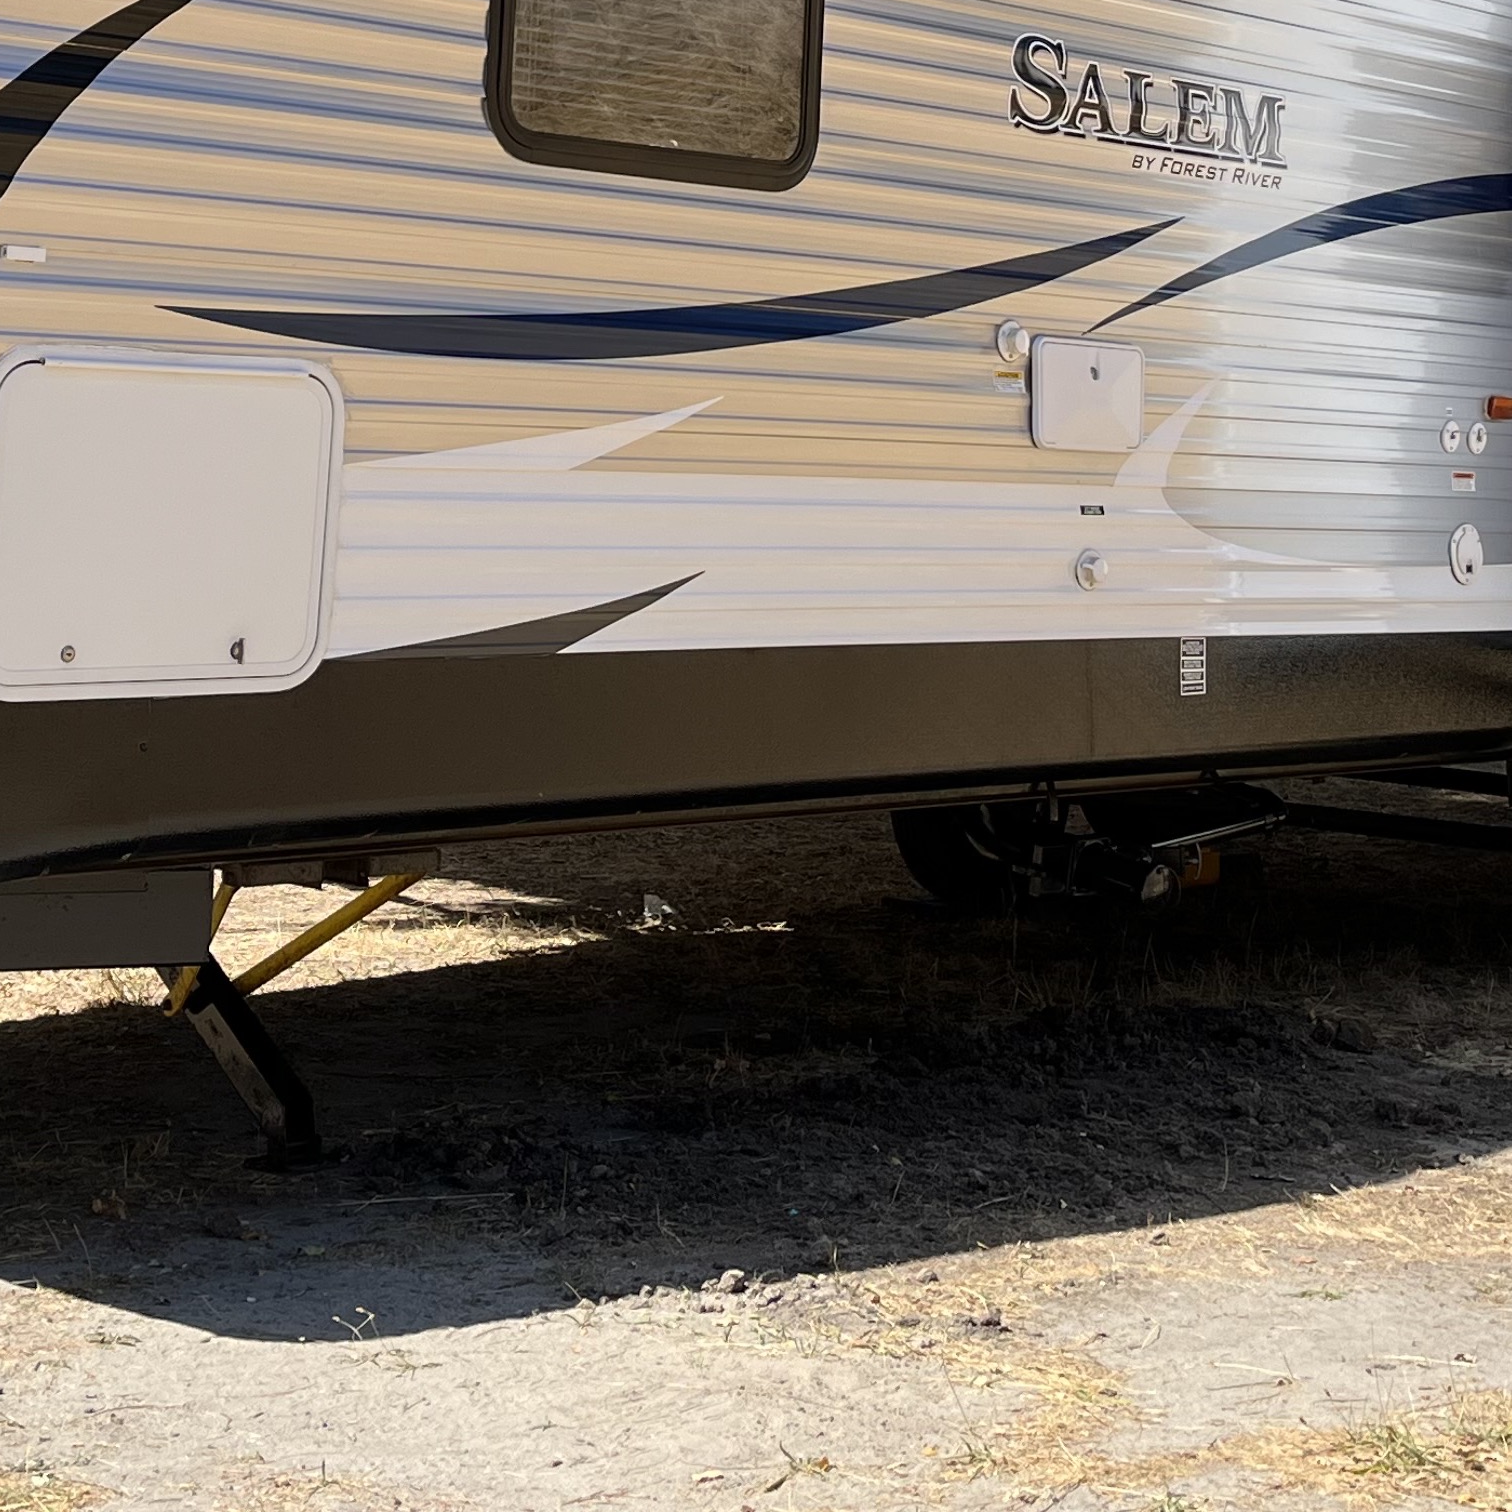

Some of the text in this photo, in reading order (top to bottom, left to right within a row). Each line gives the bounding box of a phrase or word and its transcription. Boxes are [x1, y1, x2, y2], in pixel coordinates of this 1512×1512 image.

[1008, 33, 1288, 168] SALEM
[1131, 154, 1282, 189] BY FOREST RIVER
